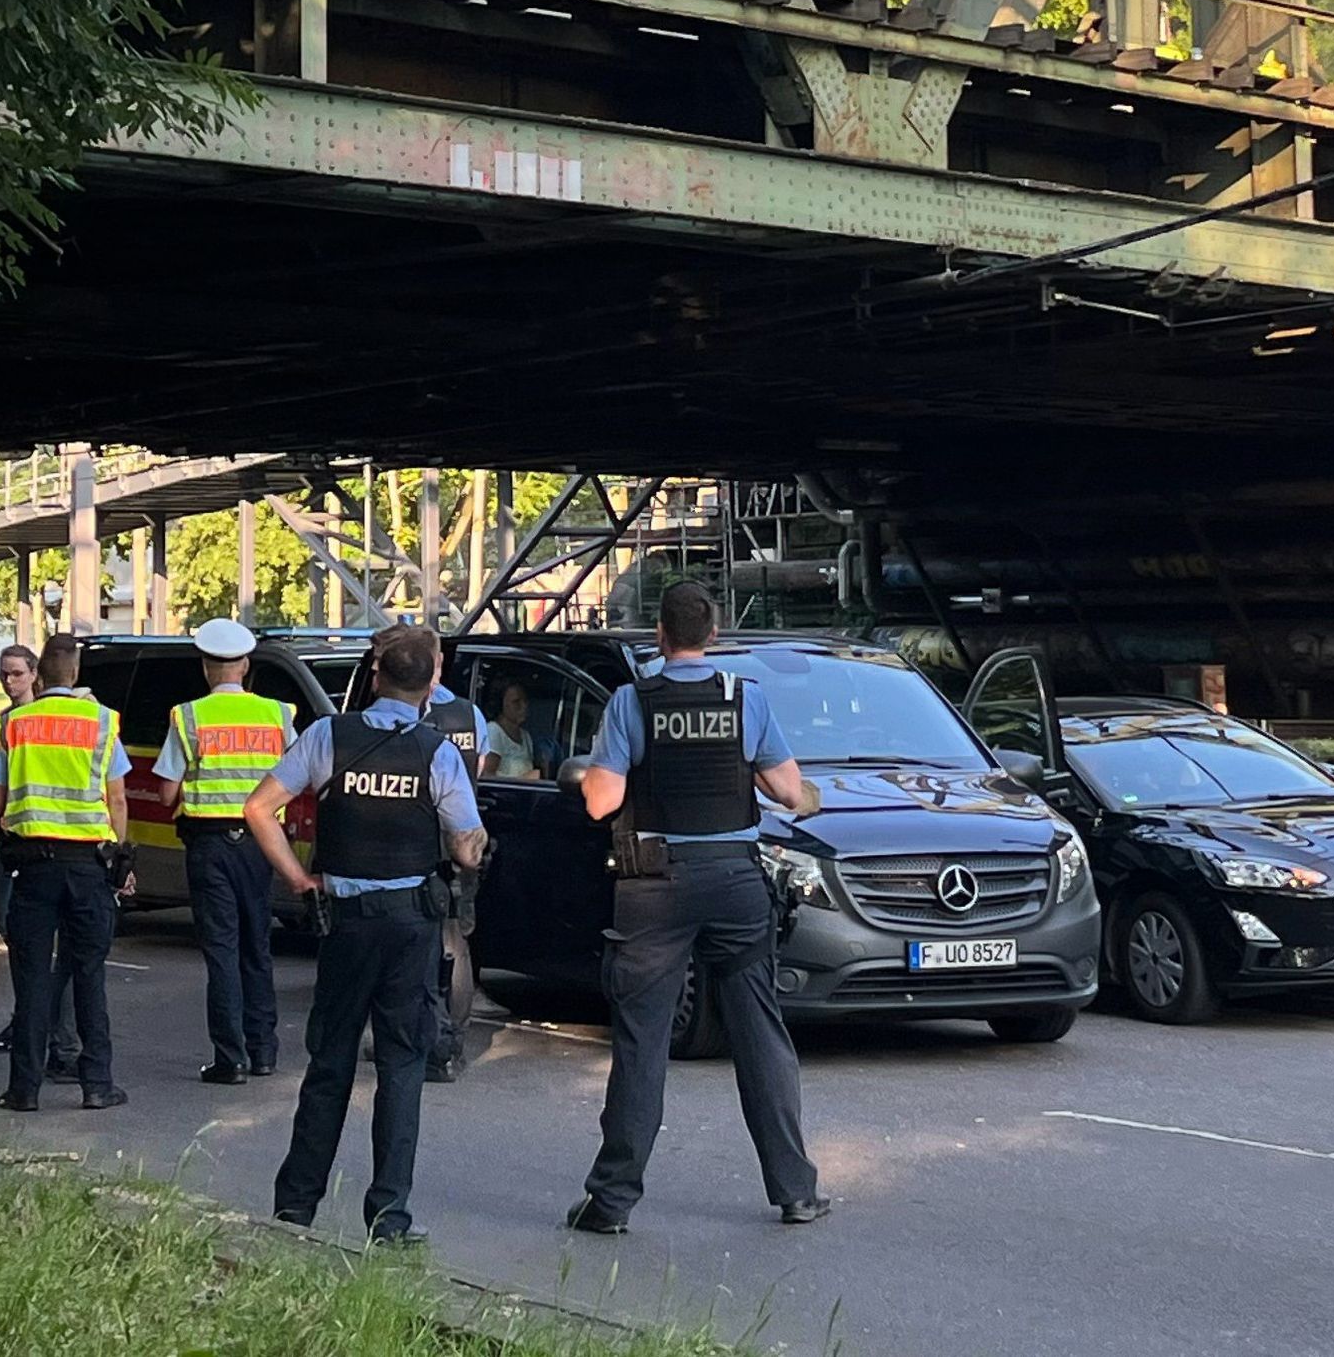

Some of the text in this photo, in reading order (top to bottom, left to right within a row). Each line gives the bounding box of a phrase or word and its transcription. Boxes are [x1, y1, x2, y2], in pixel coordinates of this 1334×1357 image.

[653, 709, 738, 739] POLIZEI
[344, 772, 419, 798] POLIZEI
[921, 945, 933, 964] F
[972, 942, 1014, 962] 8527
